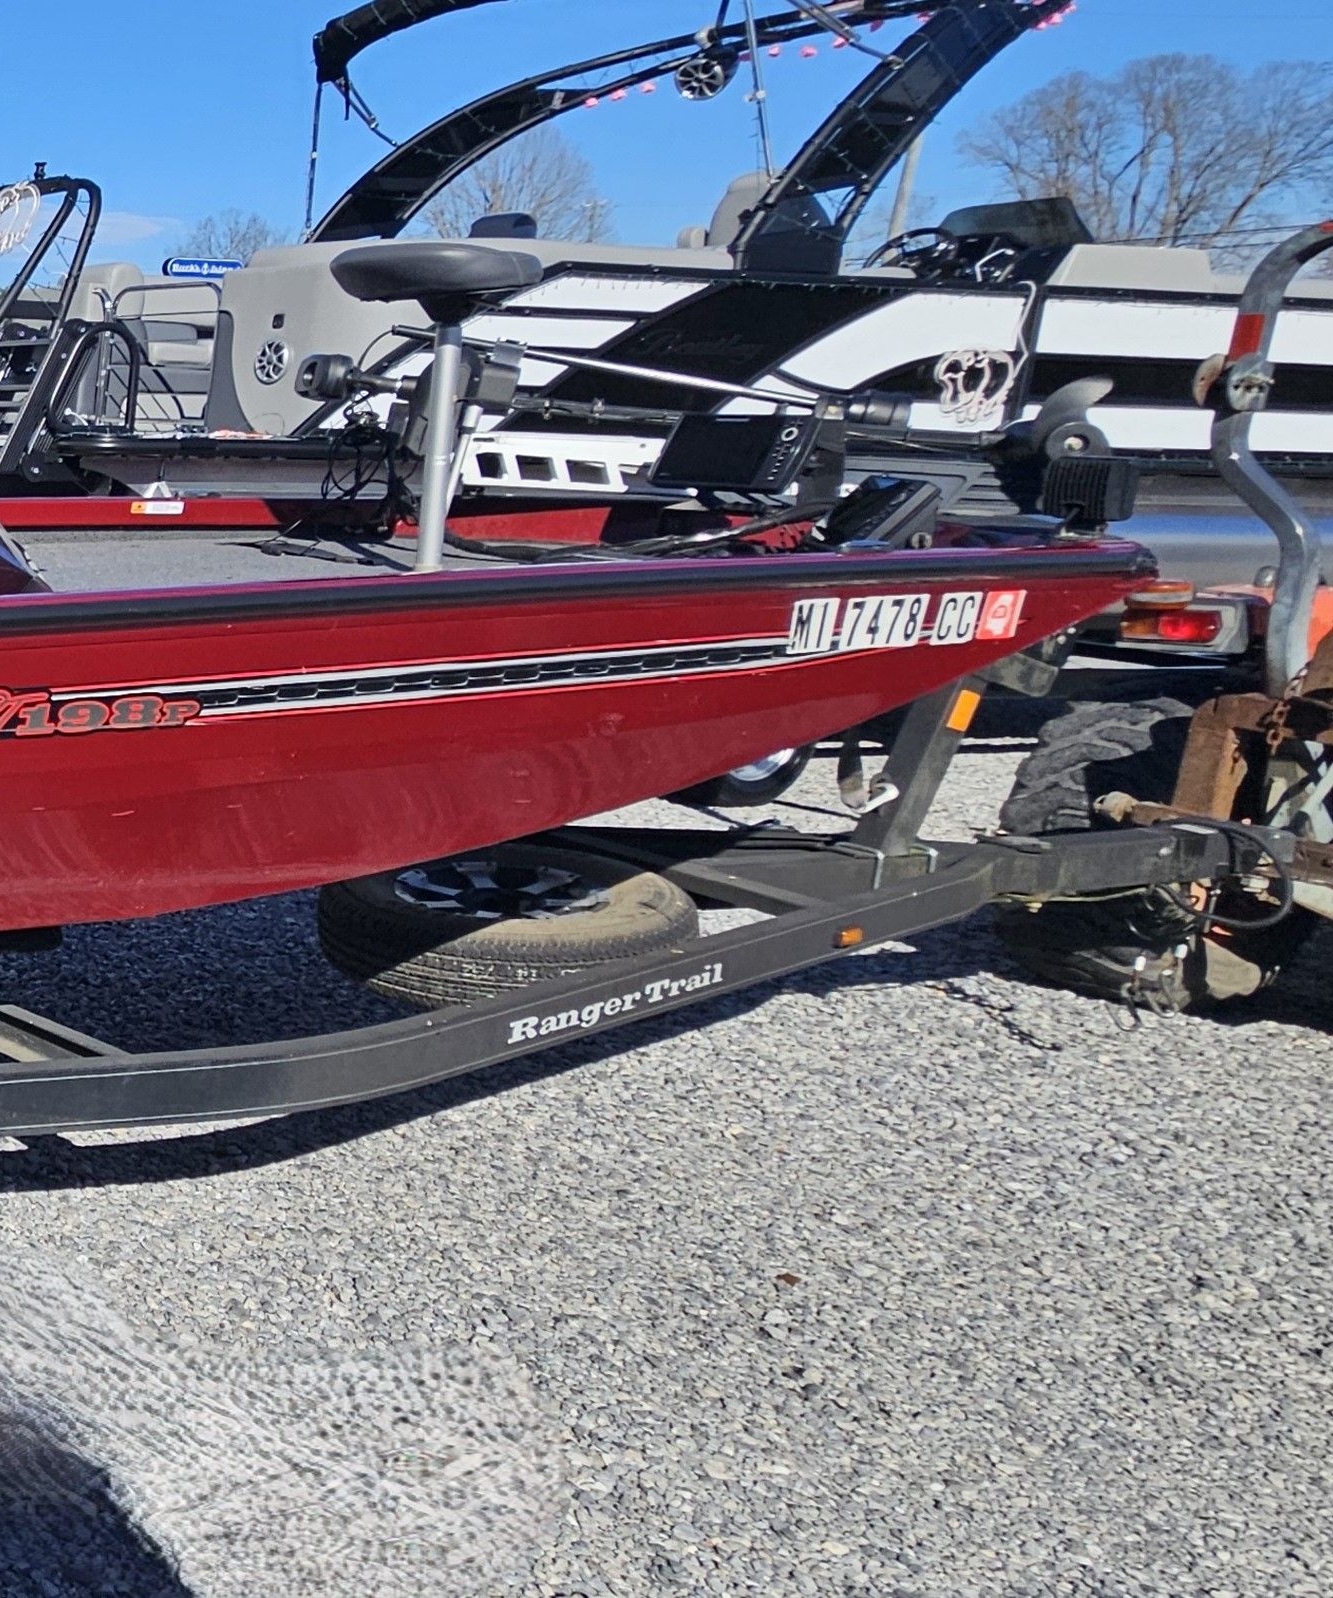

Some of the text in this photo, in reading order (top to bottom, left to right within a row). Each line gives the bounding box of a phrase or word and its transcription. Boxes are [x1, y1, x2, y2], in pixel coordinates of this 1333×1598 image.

[792, 595, 976, 650] MI 7478 CC
[507, 962, 724, 1044] Ranger Trail
